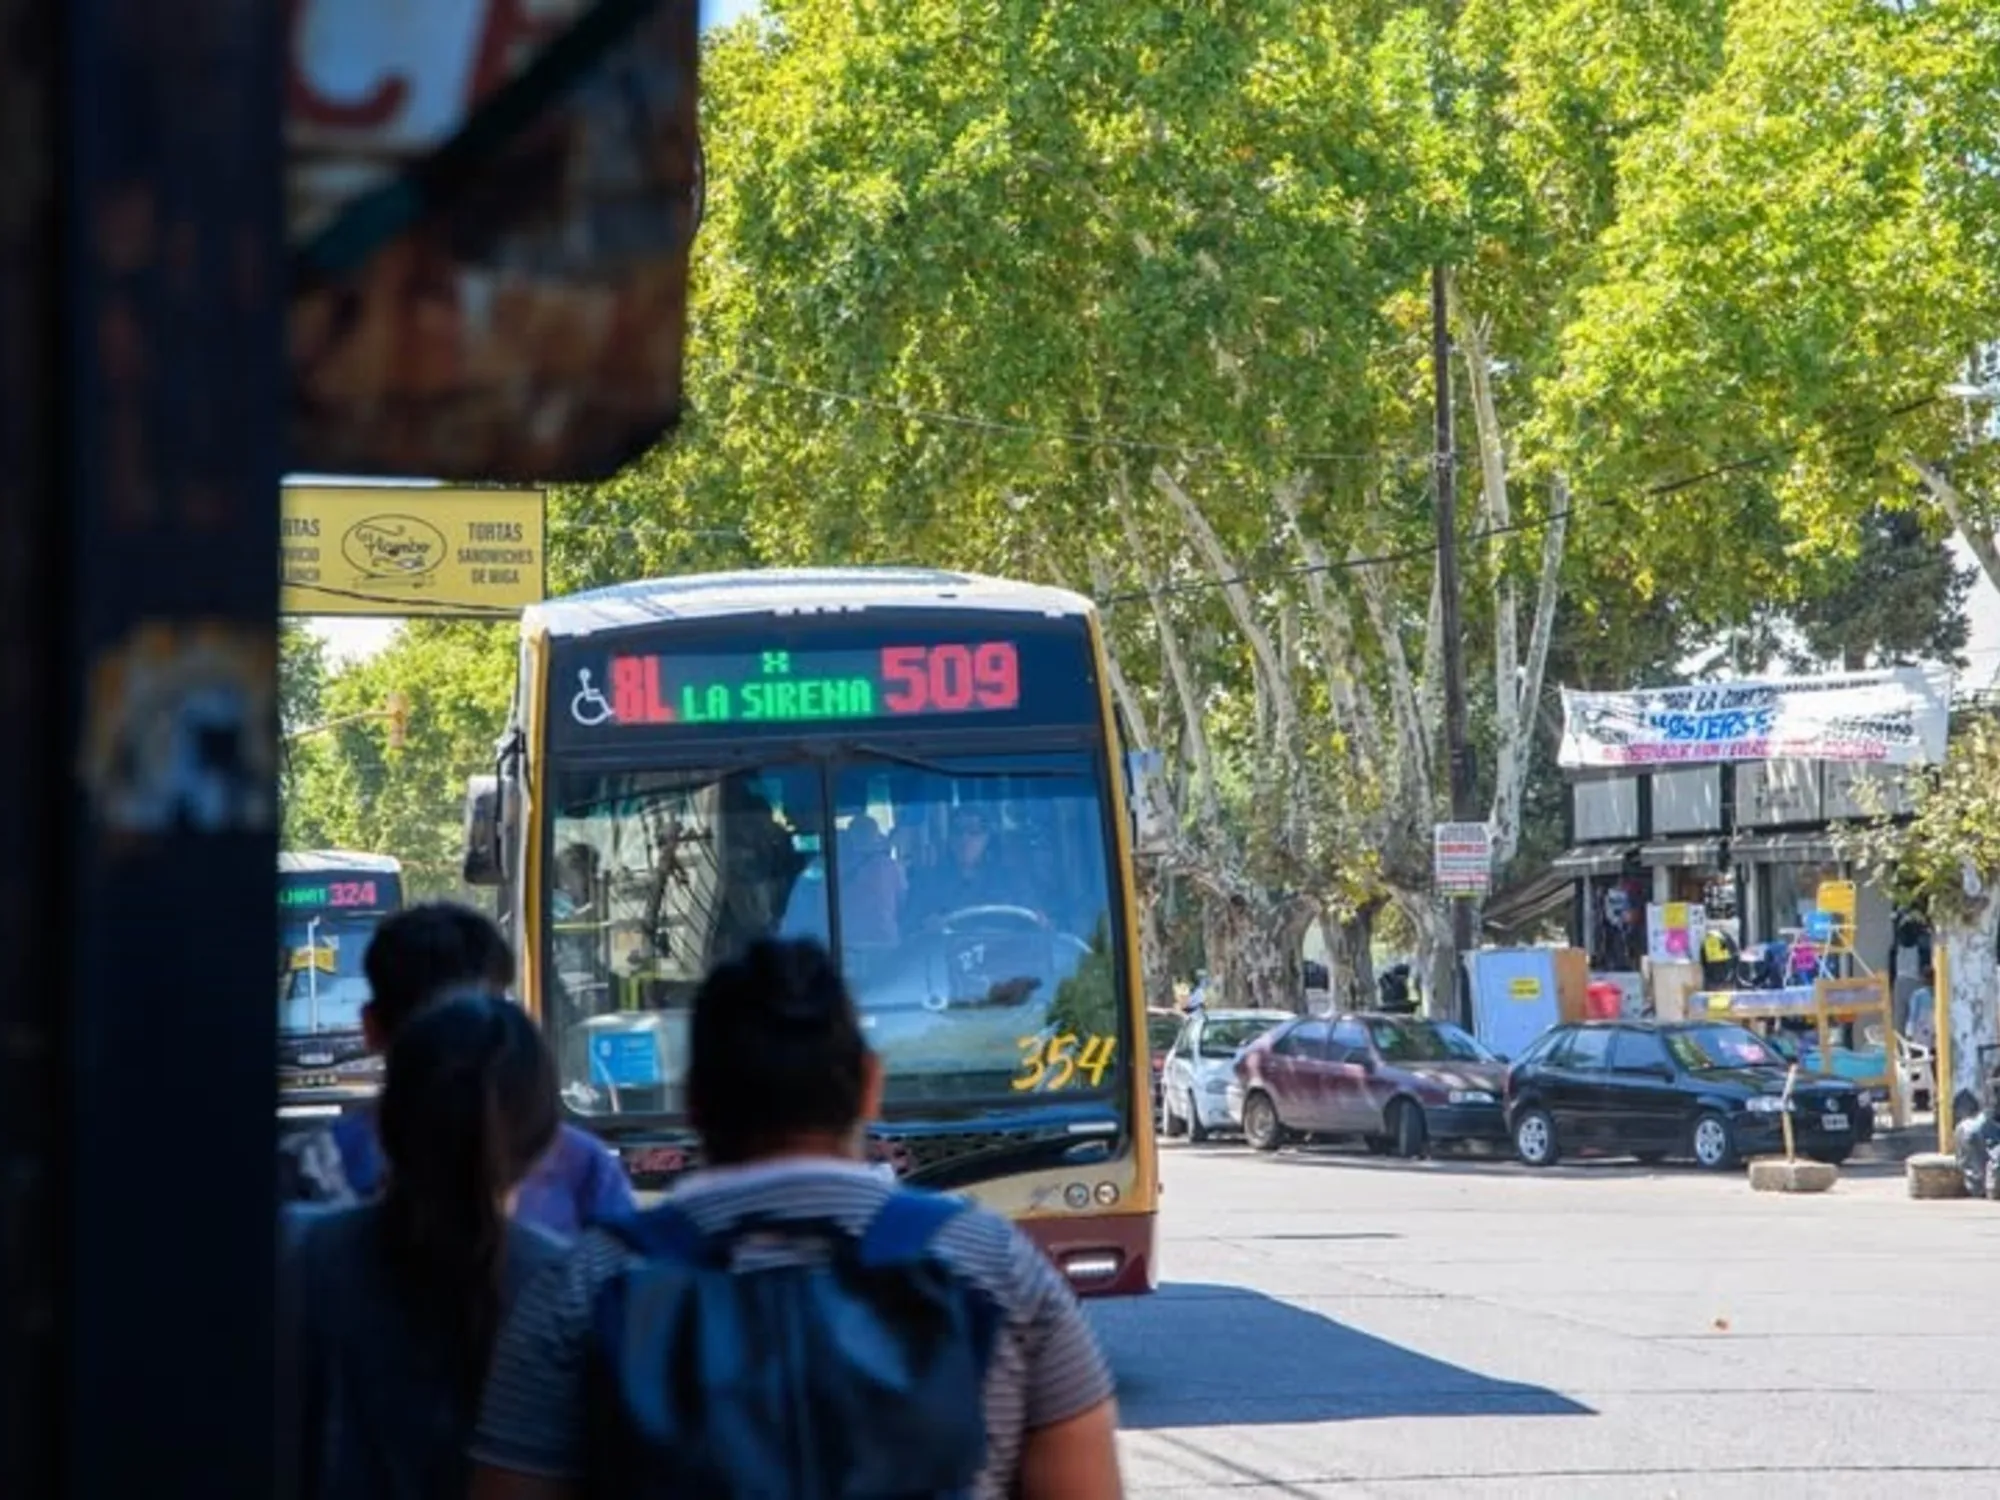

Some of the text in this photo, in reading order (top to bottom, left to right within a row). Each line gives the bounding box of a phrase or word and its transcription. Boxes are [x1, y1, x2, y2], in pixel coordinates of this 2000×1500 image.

[468, 522, 523, 542] TORTAS
[457, 547, 534, 565] SANDWICHES
[471, 567, 486, 585] DE
[881, 642, 1019, 714] 509
[682, 684, 730, 722] LA
[327, 881, 377, 909] 324
[1012, 1032, 1118, 1091] 354
